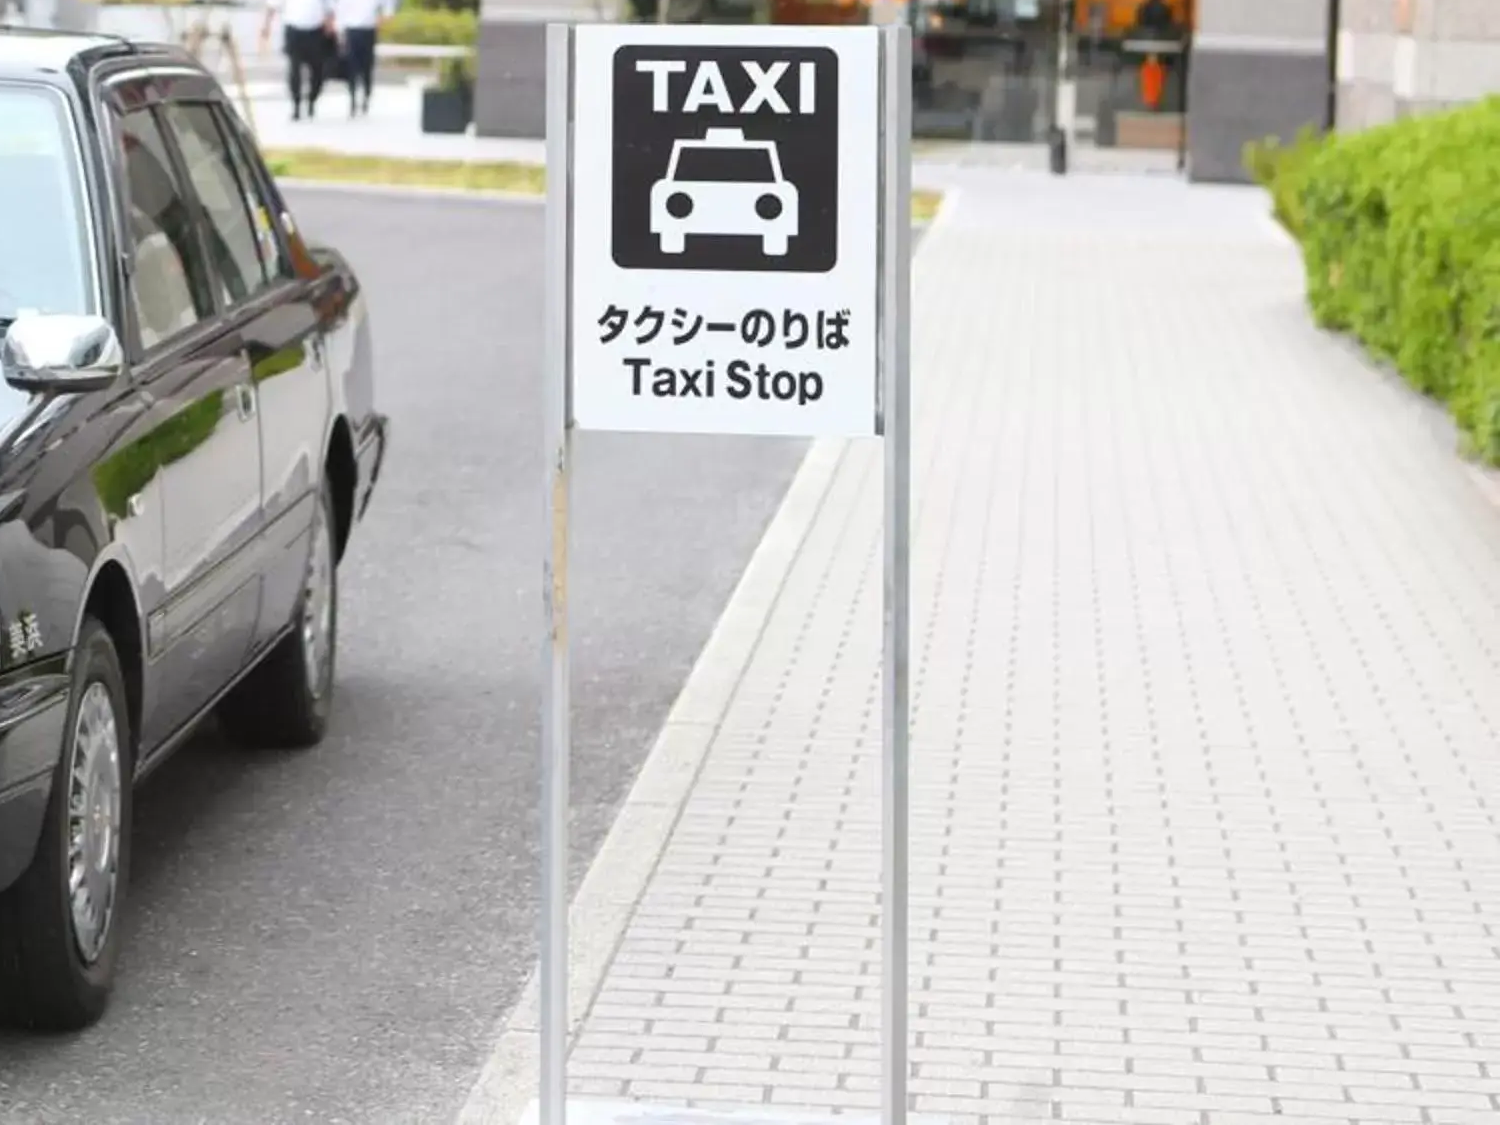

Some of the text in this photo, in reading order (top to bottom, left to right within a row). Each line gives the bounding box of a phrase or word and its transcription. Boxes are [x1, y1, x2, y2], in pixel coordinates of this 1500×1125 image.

[636, 61, 815, 113] TAXI
[598, 305, 850, 349] タクシーのりば
[623, 358, 822, 405] Taxi Stop
